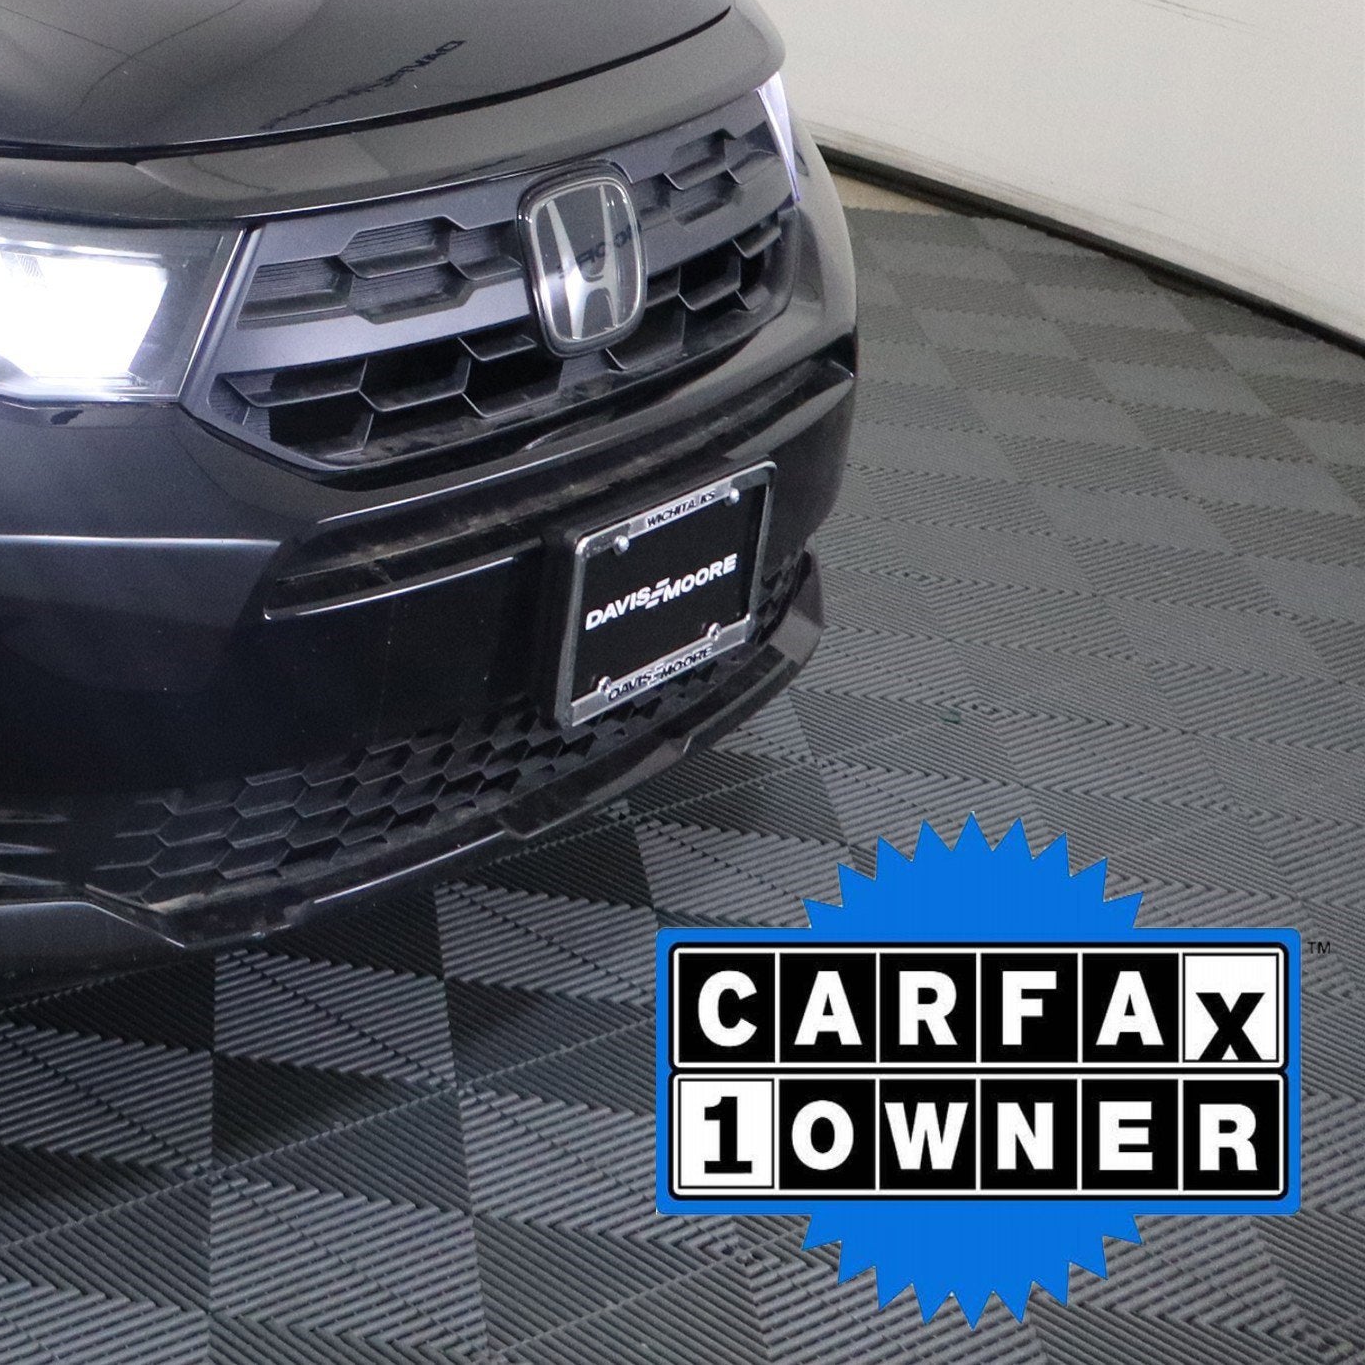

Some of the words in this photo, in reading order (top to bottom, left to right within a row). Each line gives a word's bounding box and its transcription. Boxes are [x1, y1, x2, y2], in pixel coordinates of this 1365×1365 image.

[585, 587, 651, 630] DAVIS
[663, 553, 737, 603] MOORE
[608, 669, 652, 702] DAVIS
[659, 643, 713, 680] MOORE
